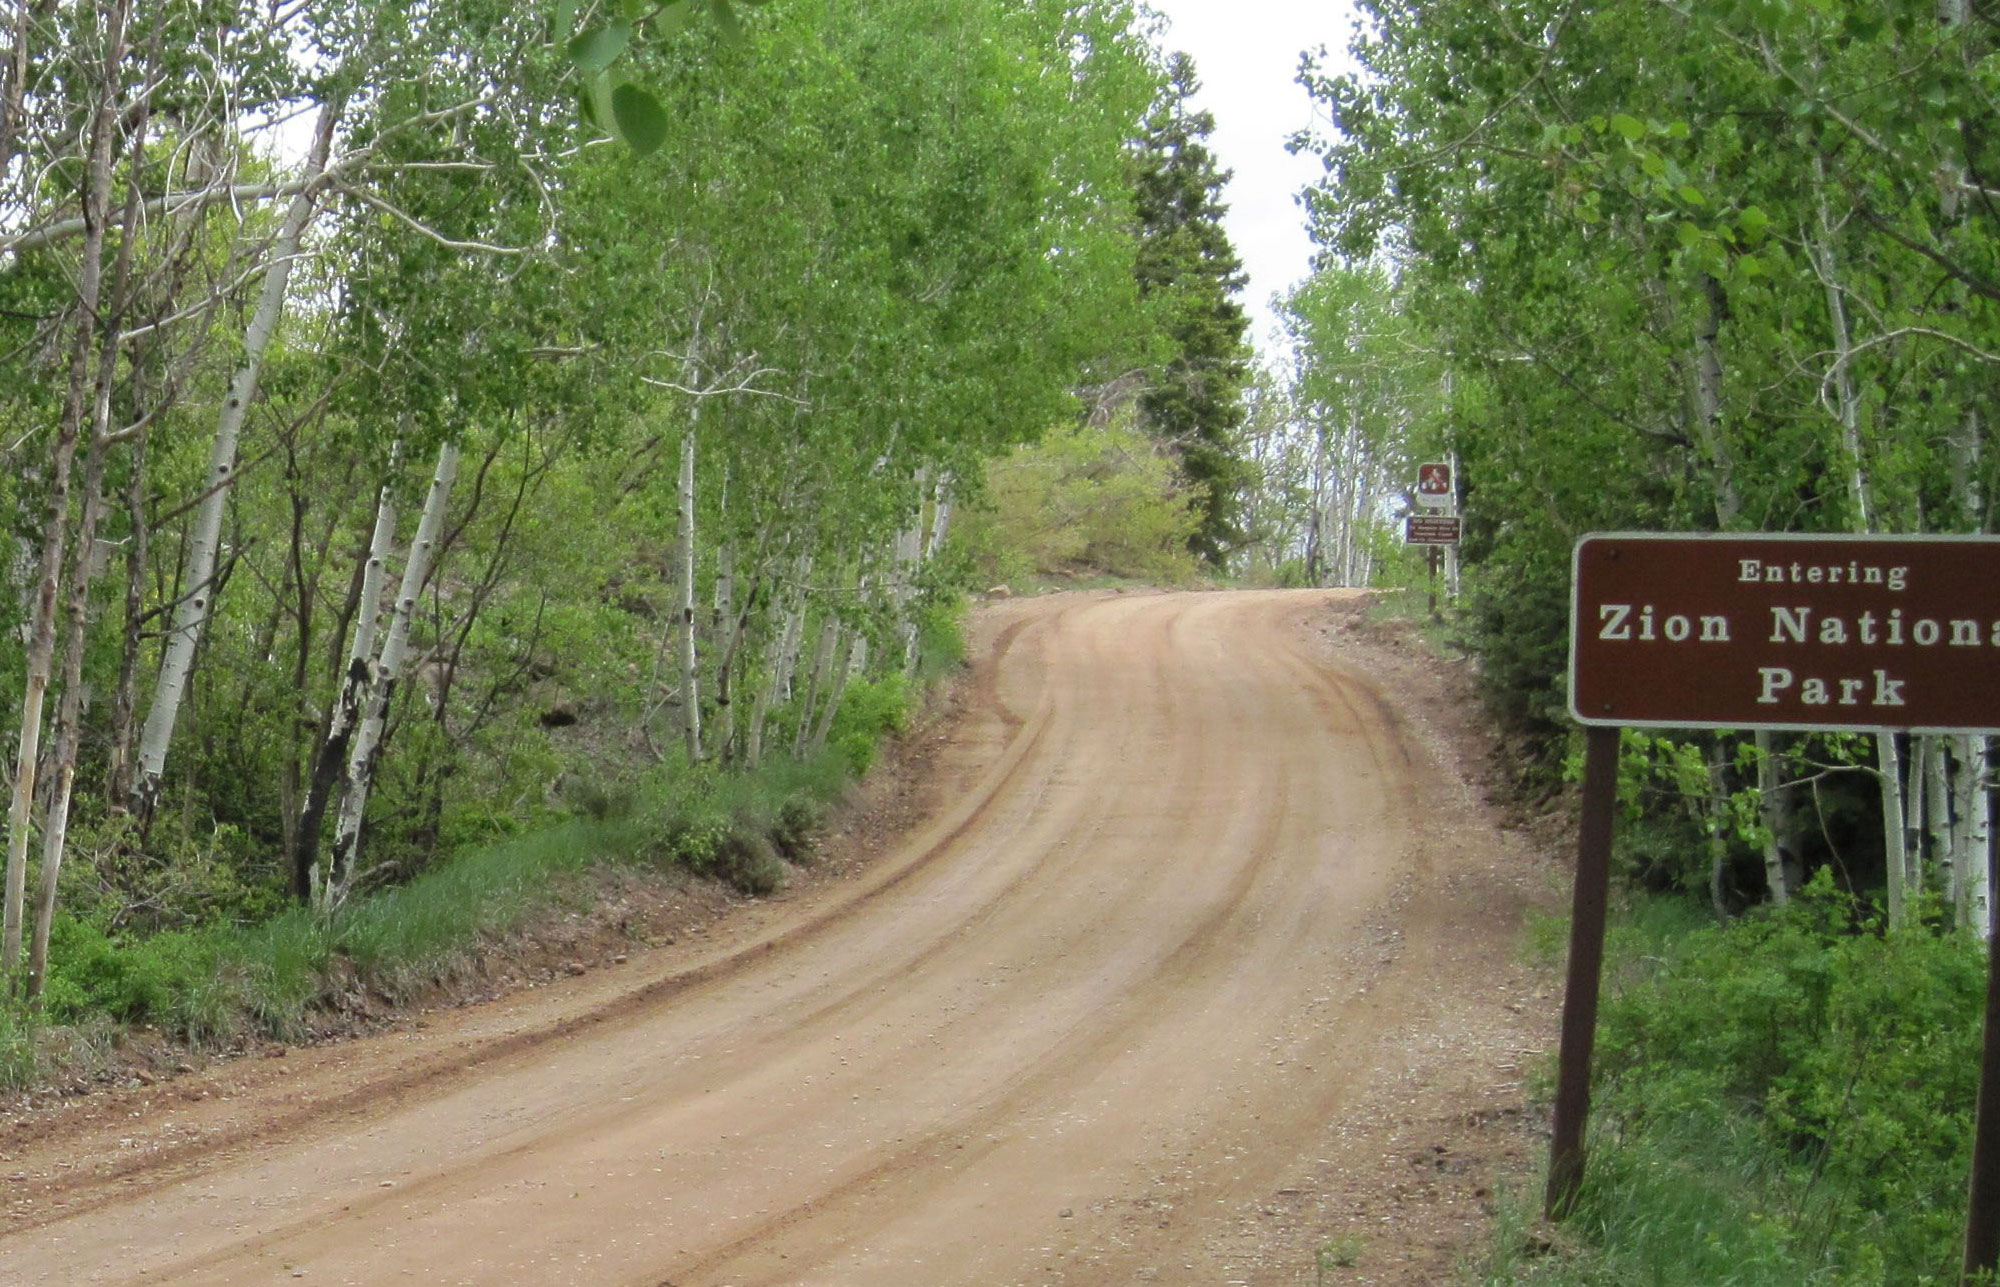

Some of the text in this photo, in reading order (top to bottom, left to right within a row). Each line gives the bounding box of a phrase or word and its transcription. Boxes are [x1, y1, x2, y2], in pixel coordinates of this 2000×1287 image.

[1738, 559, 1908, 591] Entering
[1599, 604, 1730, 642] Zion
[1757, 667, 1905, 706] Park
